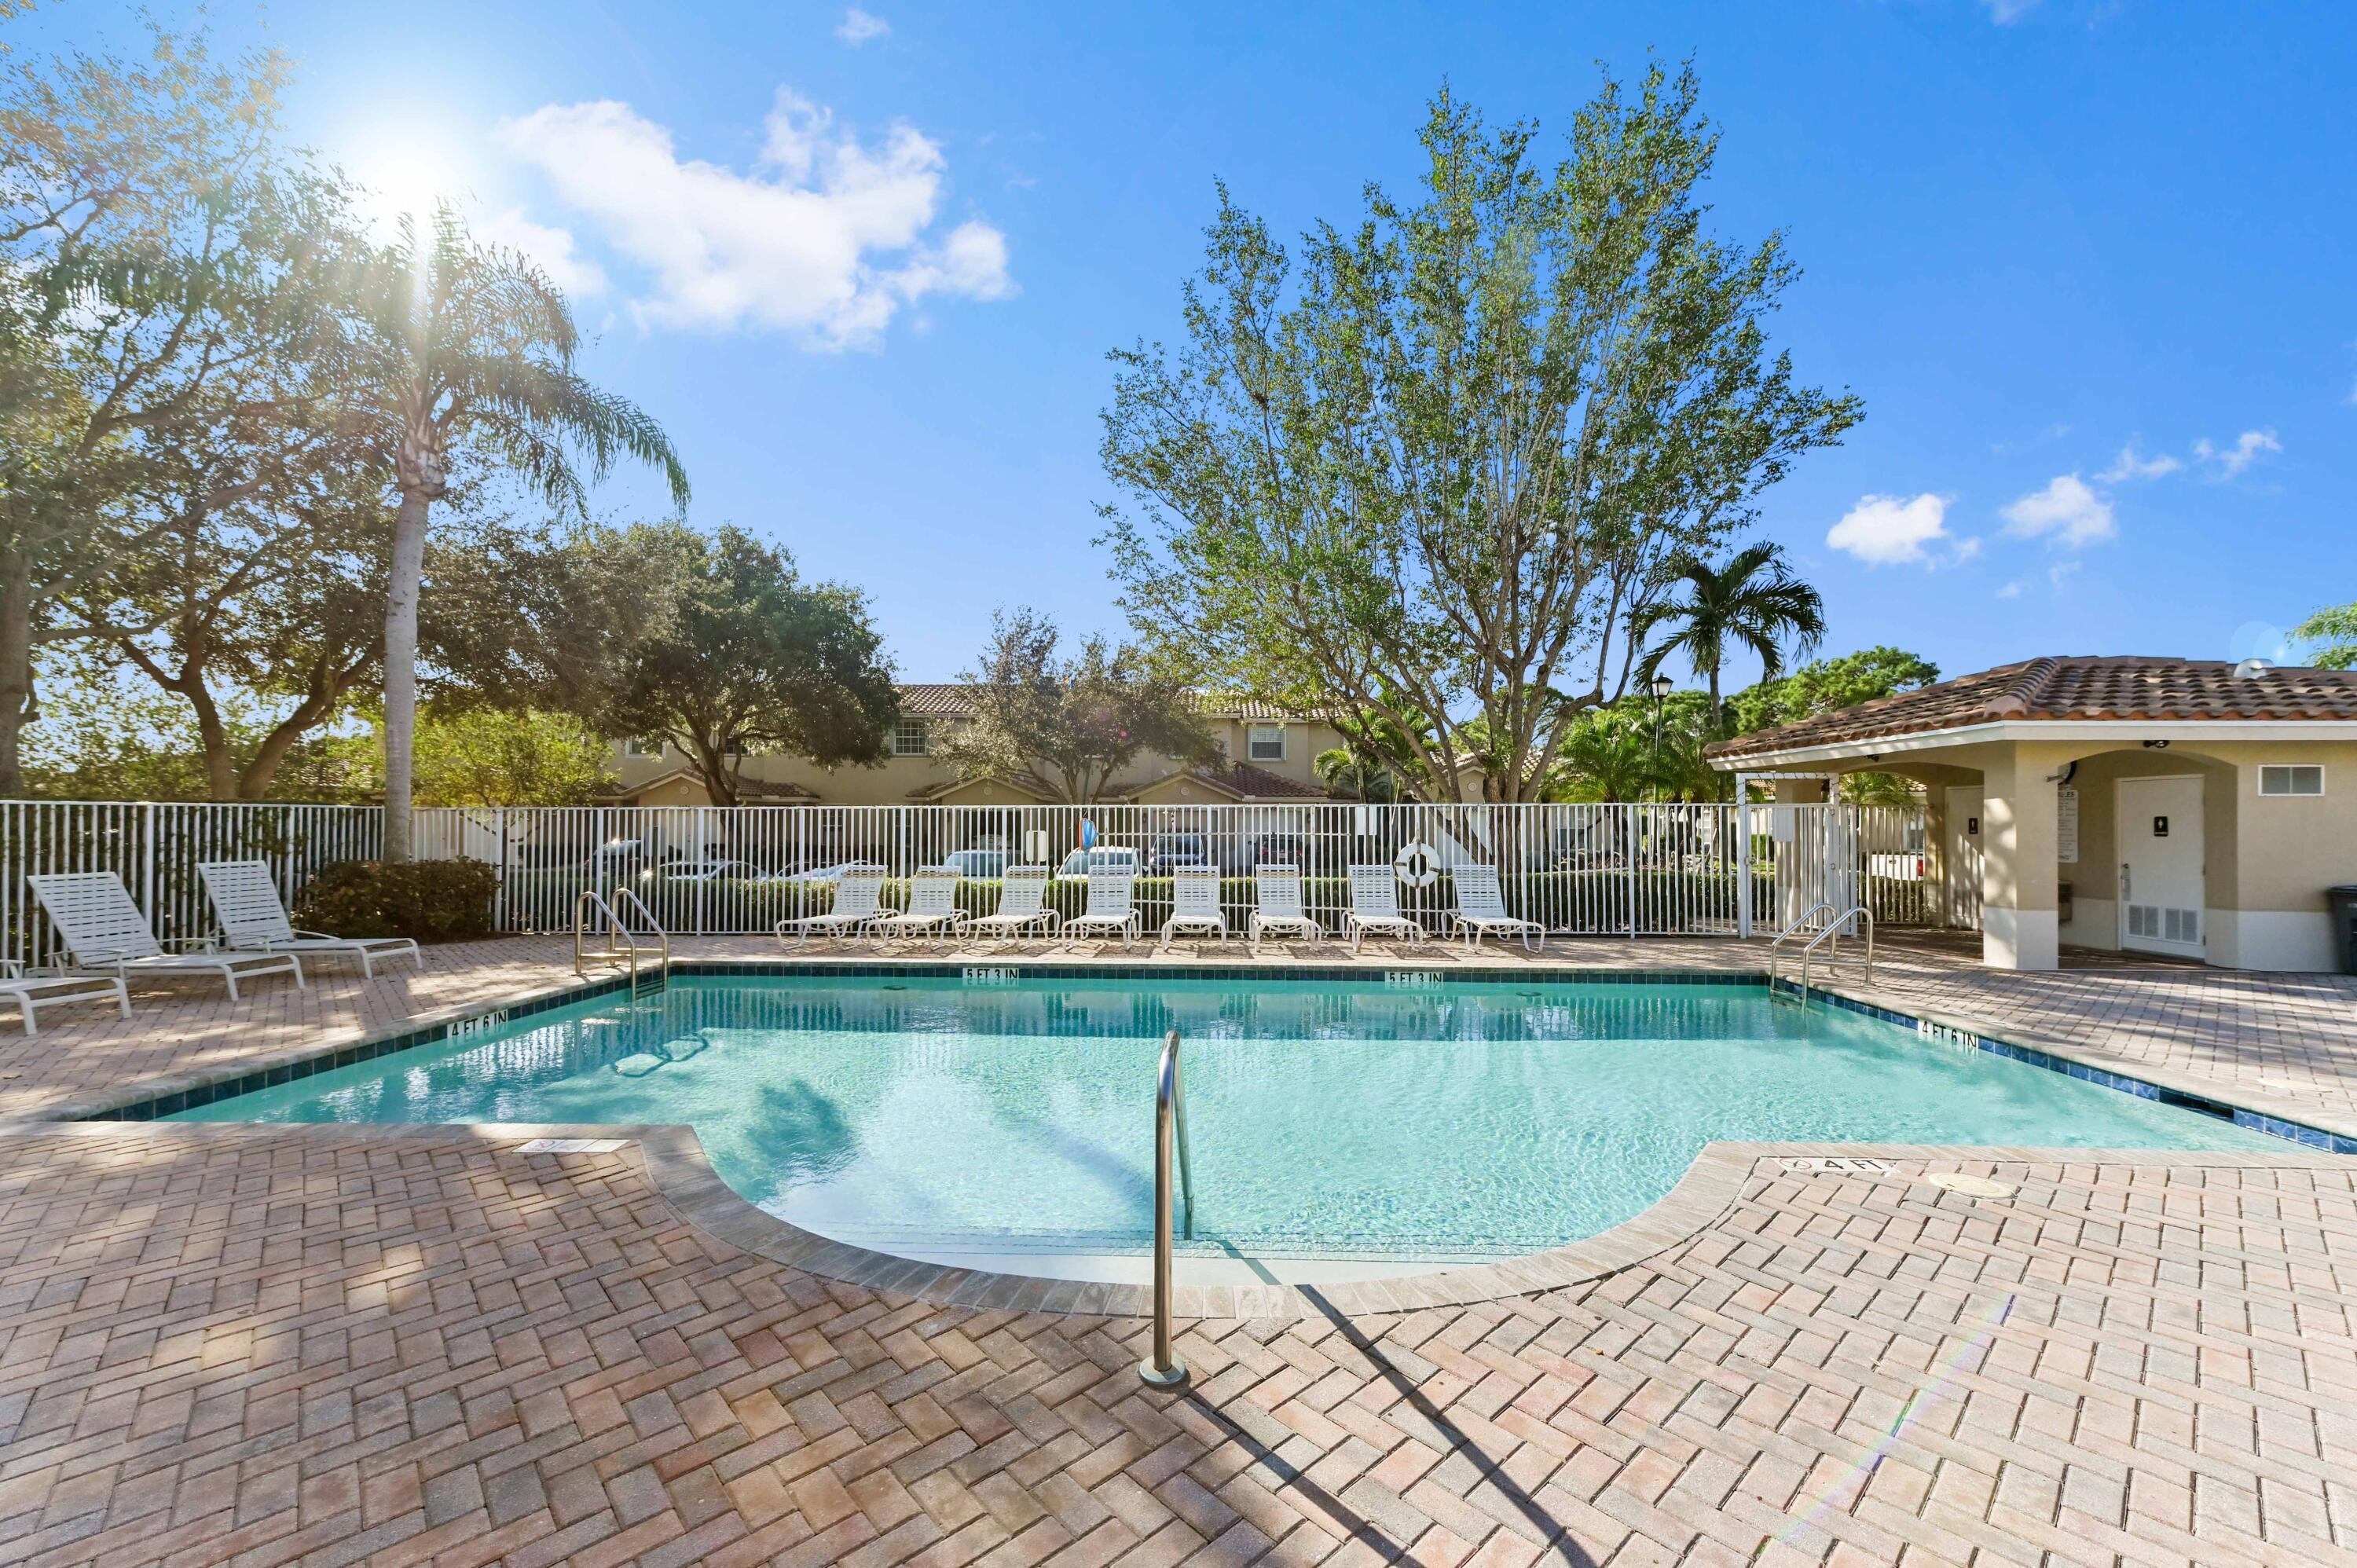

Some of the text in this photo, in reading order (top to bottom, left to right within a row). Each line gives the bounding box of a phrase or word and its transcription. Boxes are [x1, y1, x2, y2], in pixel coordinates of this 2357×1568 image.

[967, 969, 1018, 978] 5 FT 3 IN
[1389, 973, 1395, 981] 5
[1400, 973, 1413, 982] FT
[1429, 973, 1442, 982] IN
[452, 1010, 507, 1035] 4 FT 6 IN
[1923, 1021, 1977, 1047] 4 FT 6 IN
[1824, 1160, 1883, 1170] 4 FT
